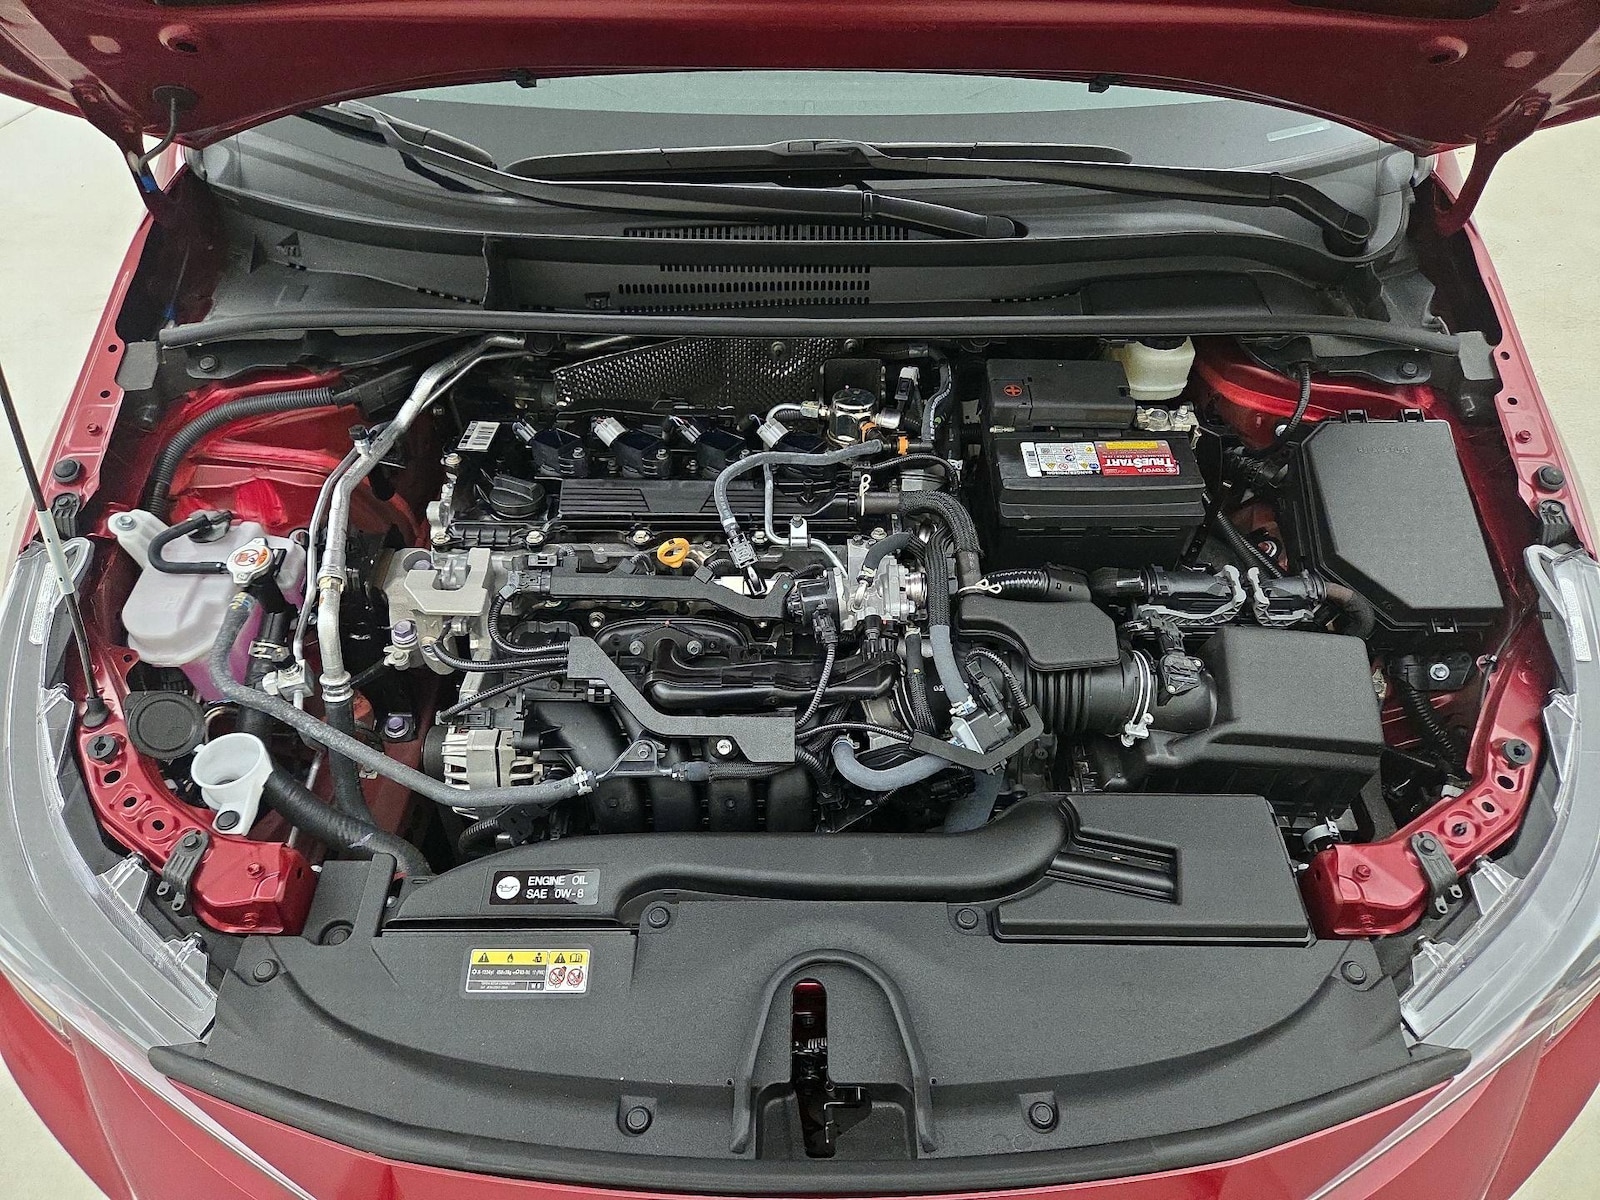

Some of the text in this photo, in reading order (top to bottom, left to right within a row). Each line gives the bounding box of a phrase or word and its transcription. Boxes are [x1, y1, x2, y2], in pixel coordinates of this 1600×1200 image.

[527, 875, 588, 886] ENGINE OIL
[525, 888, 584, 899] SAE 0W-8
